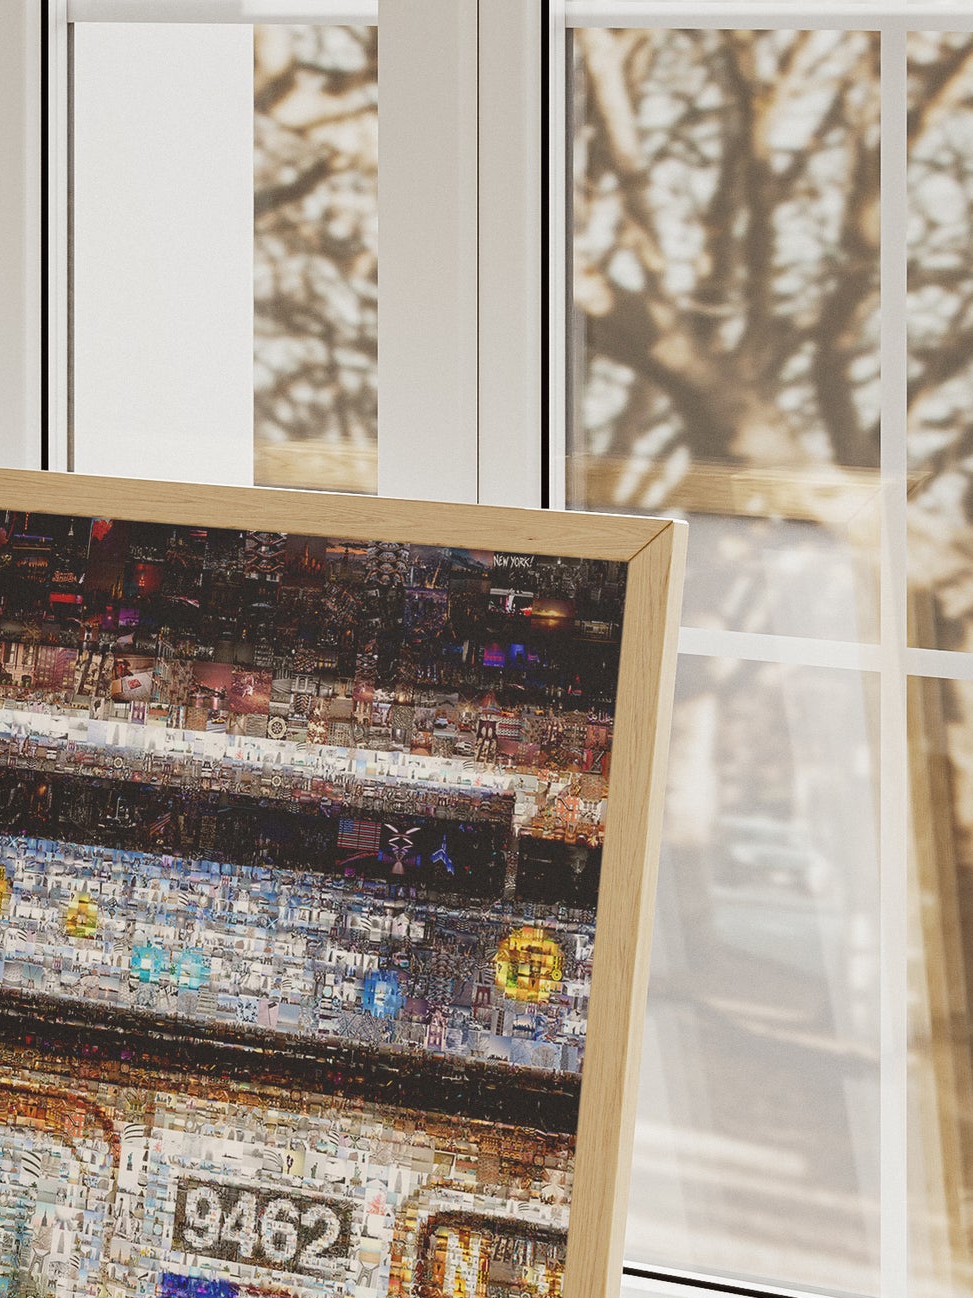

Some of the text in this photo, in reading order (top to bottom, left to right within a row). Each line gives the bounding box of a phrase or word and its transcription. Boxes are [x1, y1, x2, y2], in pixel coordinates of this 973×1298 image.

[493, 554, 534, 569] NEW YORK!
[182, 1186, 347, 1269] 9462
